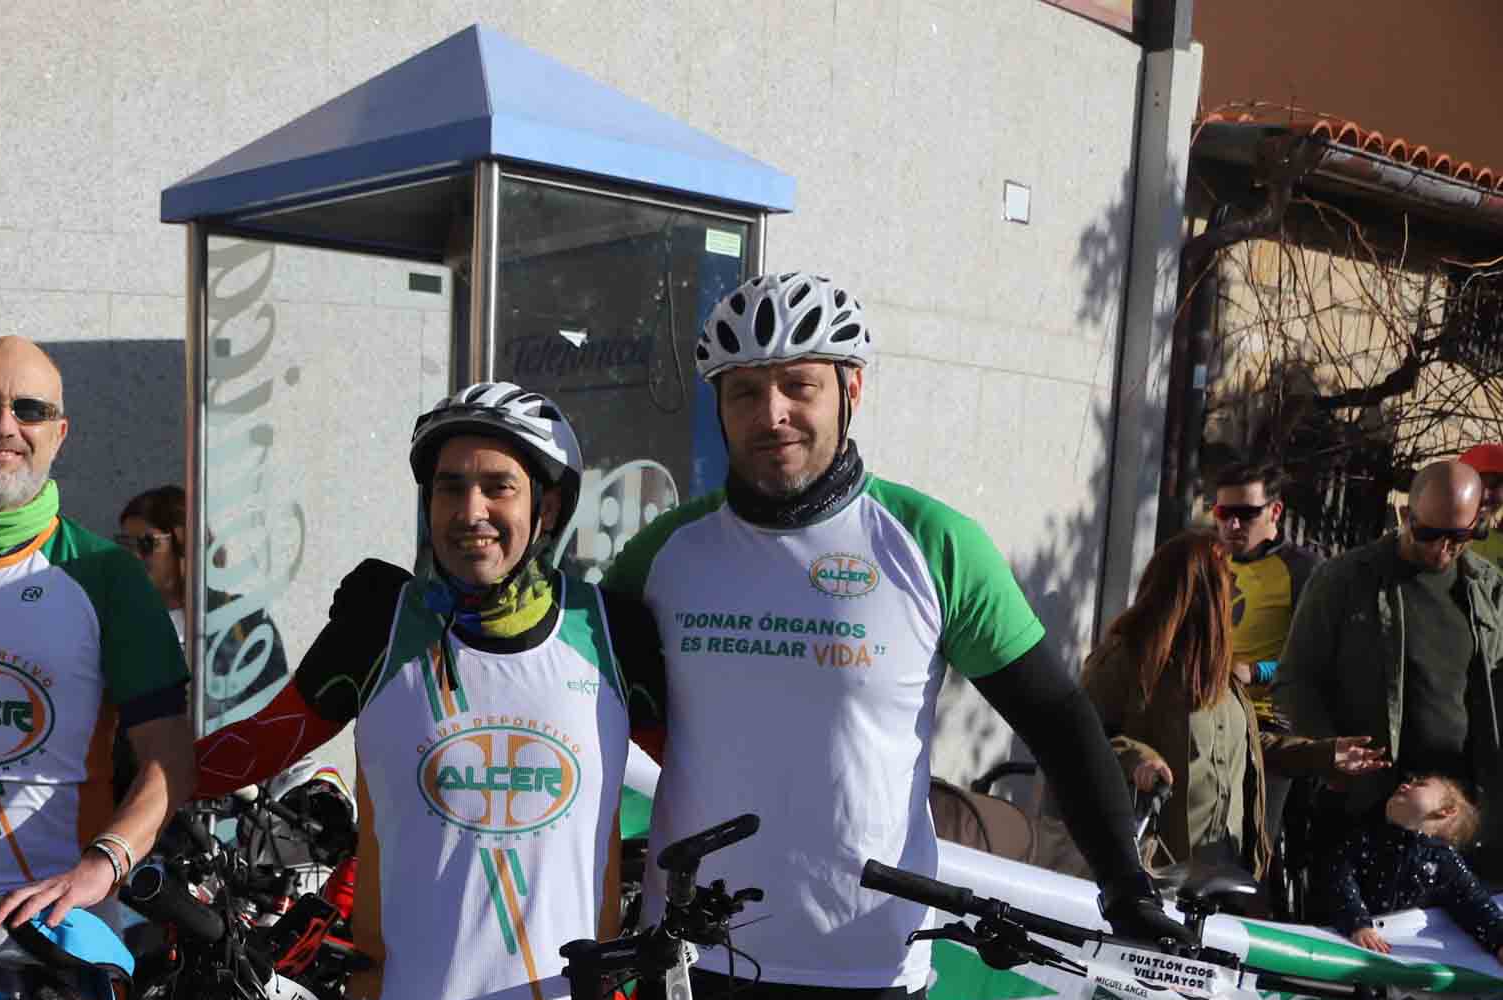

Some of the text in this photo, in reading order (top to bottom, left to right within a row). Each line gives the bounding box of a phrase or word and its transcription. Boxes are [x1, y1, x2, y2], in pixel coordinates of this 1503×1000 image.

[817, 568, 873, 586] ALCER
[758, 612, 866, 639] ÓRGANOS
[681, 637, 701, 653] ES
[707, 637, 807, 658] REGALAR
[567, 680, 600, 695] EKT
[416, 715, 581, 753] CLUB DEPORTIVO
[436, 766, 562, 798] ALCER
[1095, 976, 1122, 992] MIGUEL
[1134, 967, 1205, 989] VILLAMAYOR
